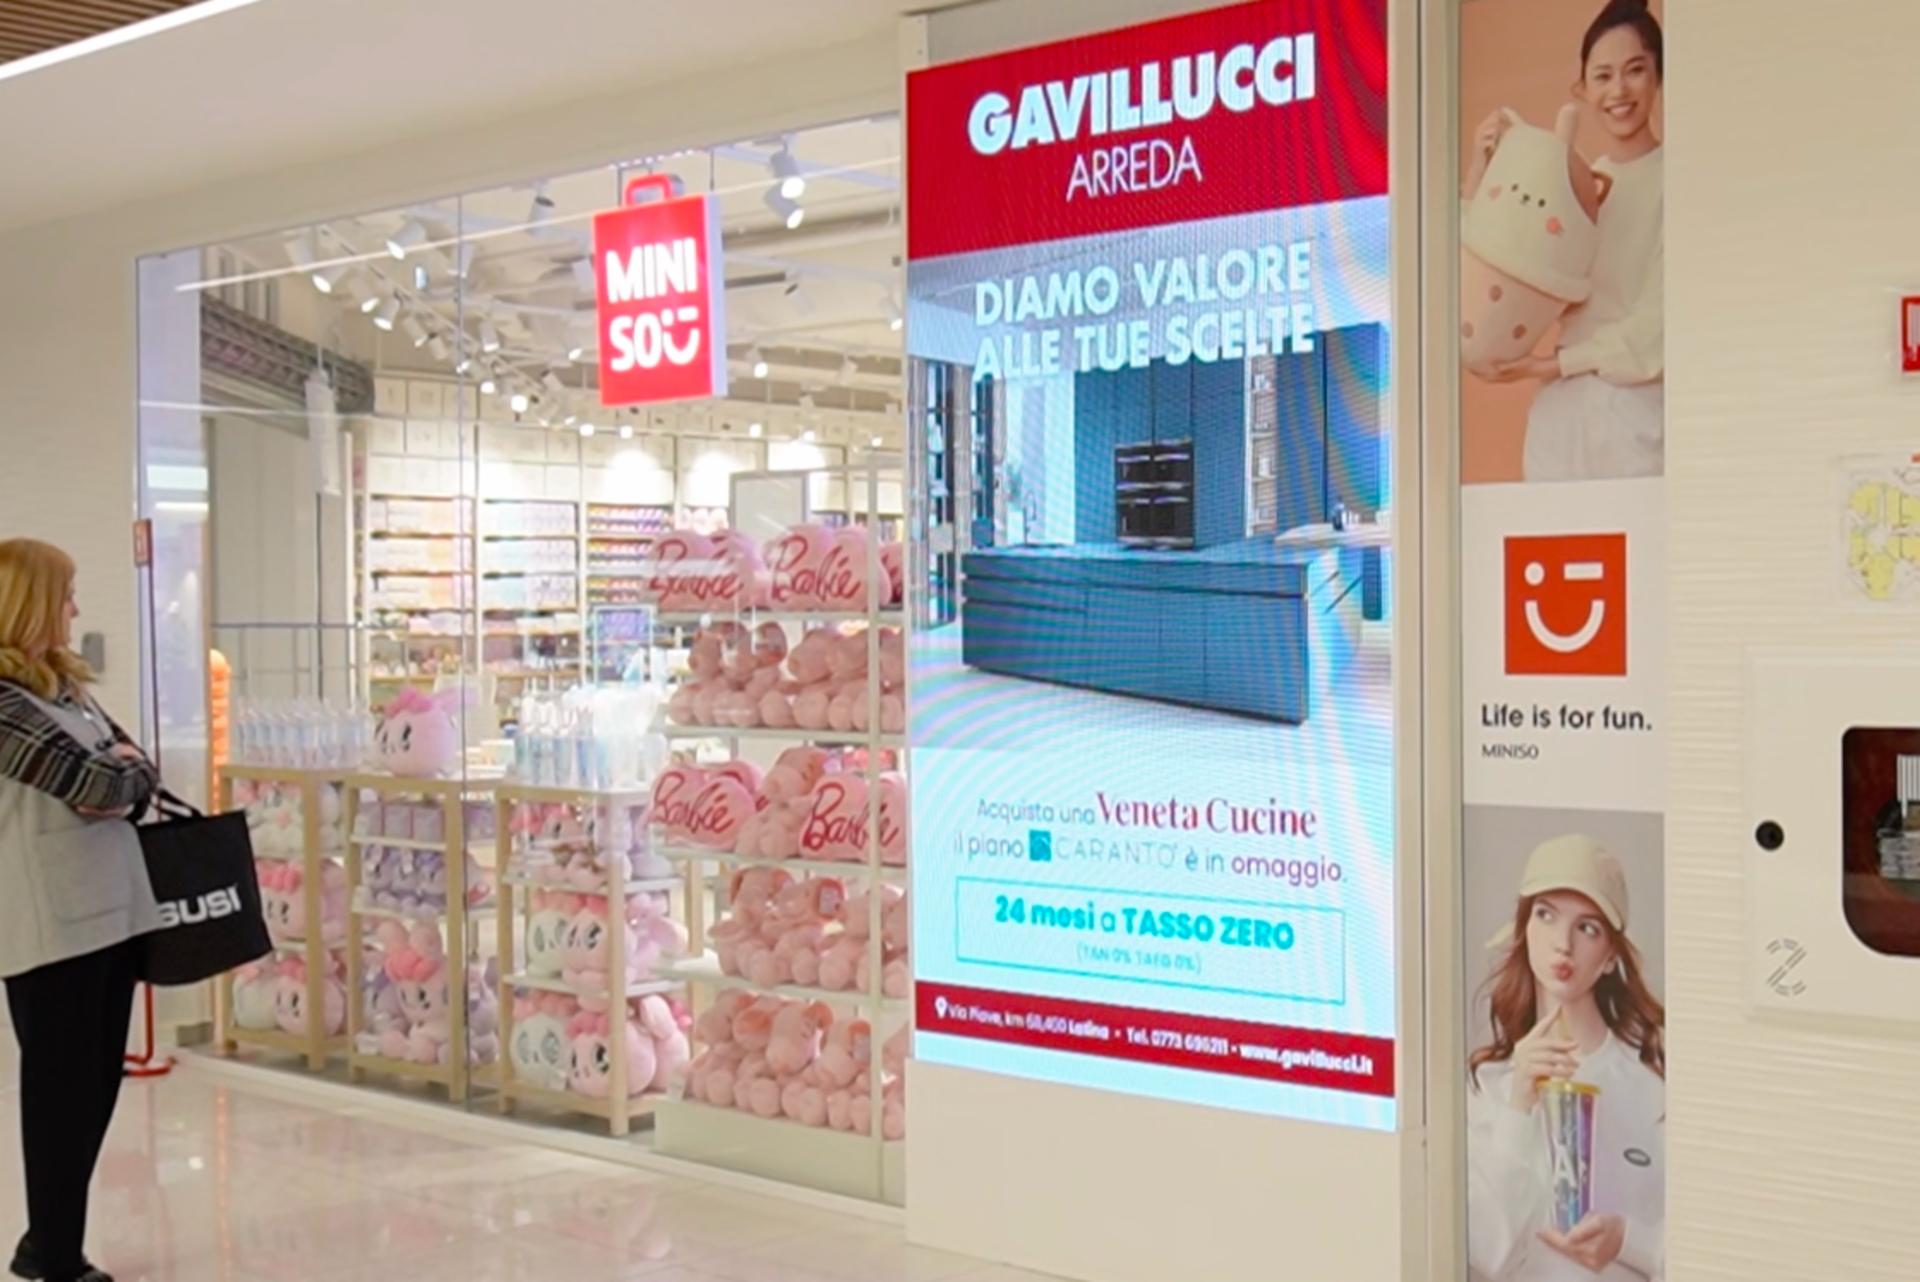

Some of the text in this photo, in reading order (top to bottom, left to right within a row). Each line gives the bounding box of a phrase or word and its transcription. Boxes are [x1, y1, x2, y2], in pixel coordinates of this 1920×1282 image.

[968, 33, 1315, 155] GAVILLUCCI
[1067, 136, 1203, 202] ARREDA
[606, 237, 697, 303] MINI
[975, 241, 1312, 326] DIAMO VALORE
[973, 302, 1314, 383] ALLE TUE SCELTE
[1482, 704, 1652, 731] Life is for fun.
[1482, 743, 1539, 759] MINISO
[977, 791, 1317, 839] Acquista una Veneta Cucine
[968, 833, 1025, 862] piano
[1185, 847, 1199, 872] è
[1205, 851, 1225, 874] in
[1231, 854, 1347, 888] omaggio.
[995, 895, 1295, 950] 24 mesi a TASSO ZERO
[949, 1004, 968, 1020] Via
[1005, 1010, 1025, 1028] km
[1068, 1018, 1109, 1039] Latina
[1126, 1026, 1149, 1046] Tel.
[1239, 1044, 1374, 1076] www.gavillucci.it
